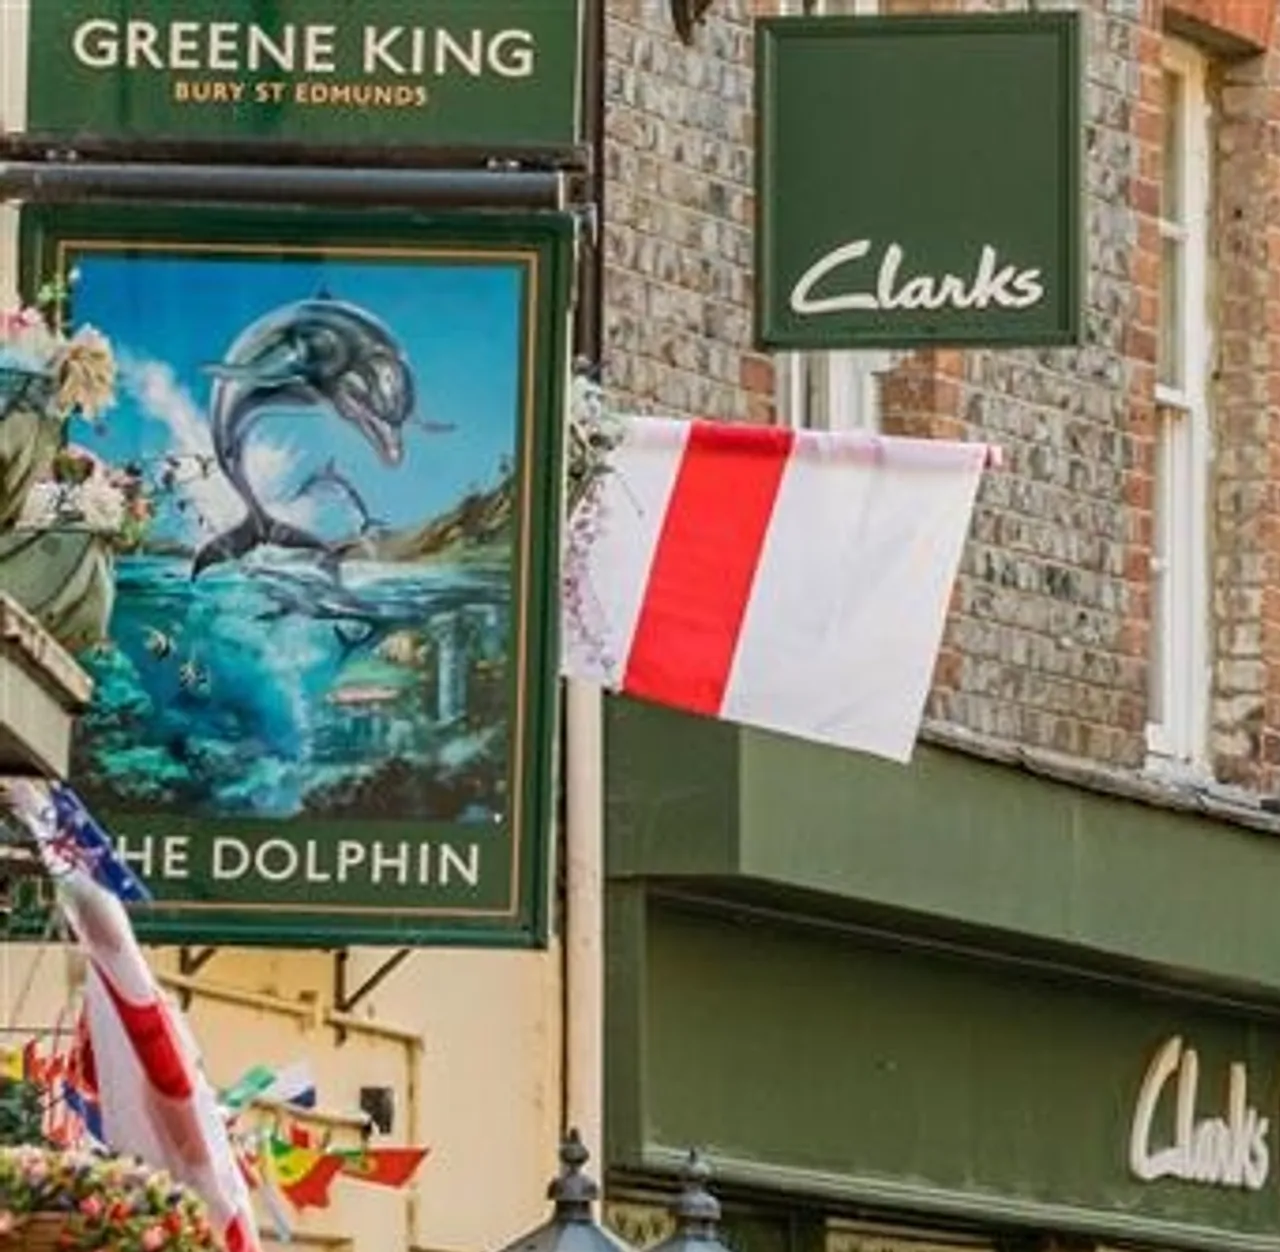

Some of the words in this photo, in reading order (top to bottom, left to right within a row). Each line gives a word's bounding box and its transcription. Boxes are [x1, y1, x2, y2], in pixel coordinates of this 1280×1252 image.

[72, 18, 336, 75] GREENE
[363, 26, 535, 79] KING
[174, 80, 244, 102] BURY
[255, 82, 285, 103] ST
[295, 84, 428, 107] EDMUNDS
[790, 238, 1045, 315] Clarks
[112, 834, 190, 878] HE
[211, 836, 481, 888] DOLPHIN
[1129, 1033, 1271, 1192] Clarks
